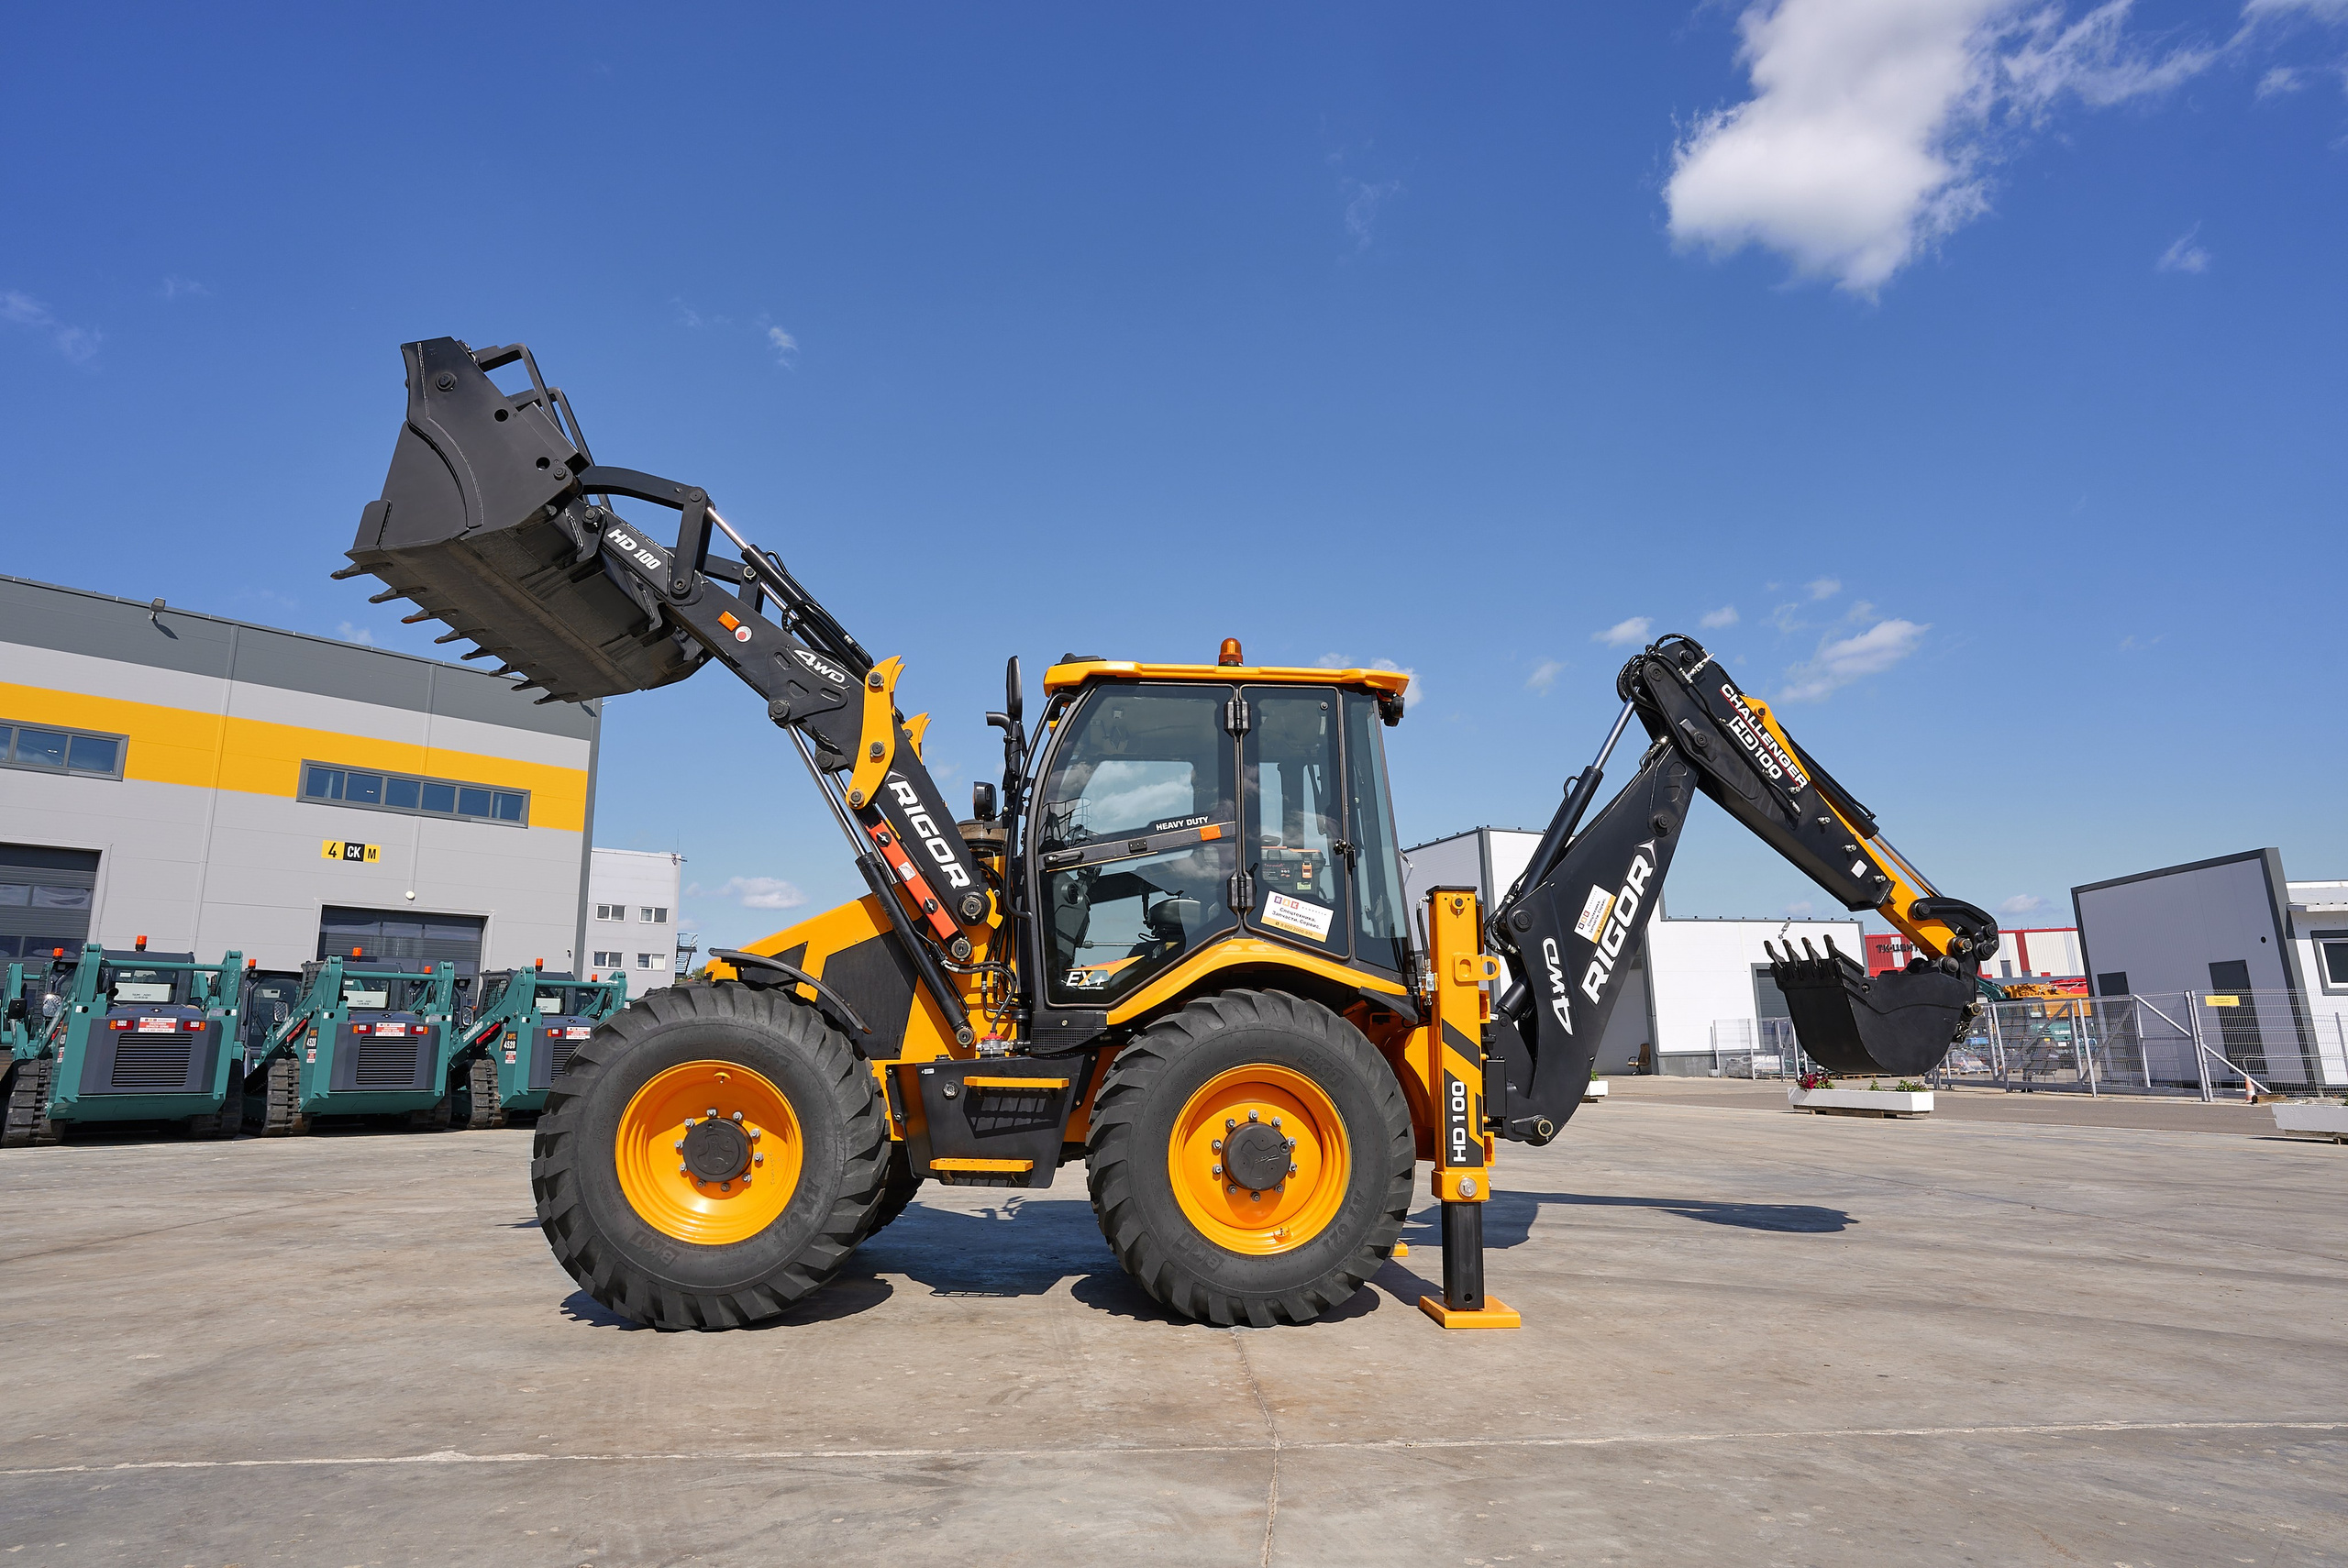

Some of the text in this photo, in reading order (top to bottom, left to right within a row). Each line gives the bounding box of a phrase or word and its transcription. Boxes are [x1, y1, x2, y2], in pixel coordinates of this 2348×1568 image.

[607, 528, 661, 569] HD 100
[794, 649, 845, 683] 4WD
[1721, 683, 1808, 789] CHALLENGER
[327, 842, 338, 858] 4
[888, 780, 971, 889] RIGOR
[1156, 816, 1209, 831] HEAVY DUTY
[1581, 855, 1654, 1005] RIGOR
[1543, 938, 1574, 1035] 4WD
